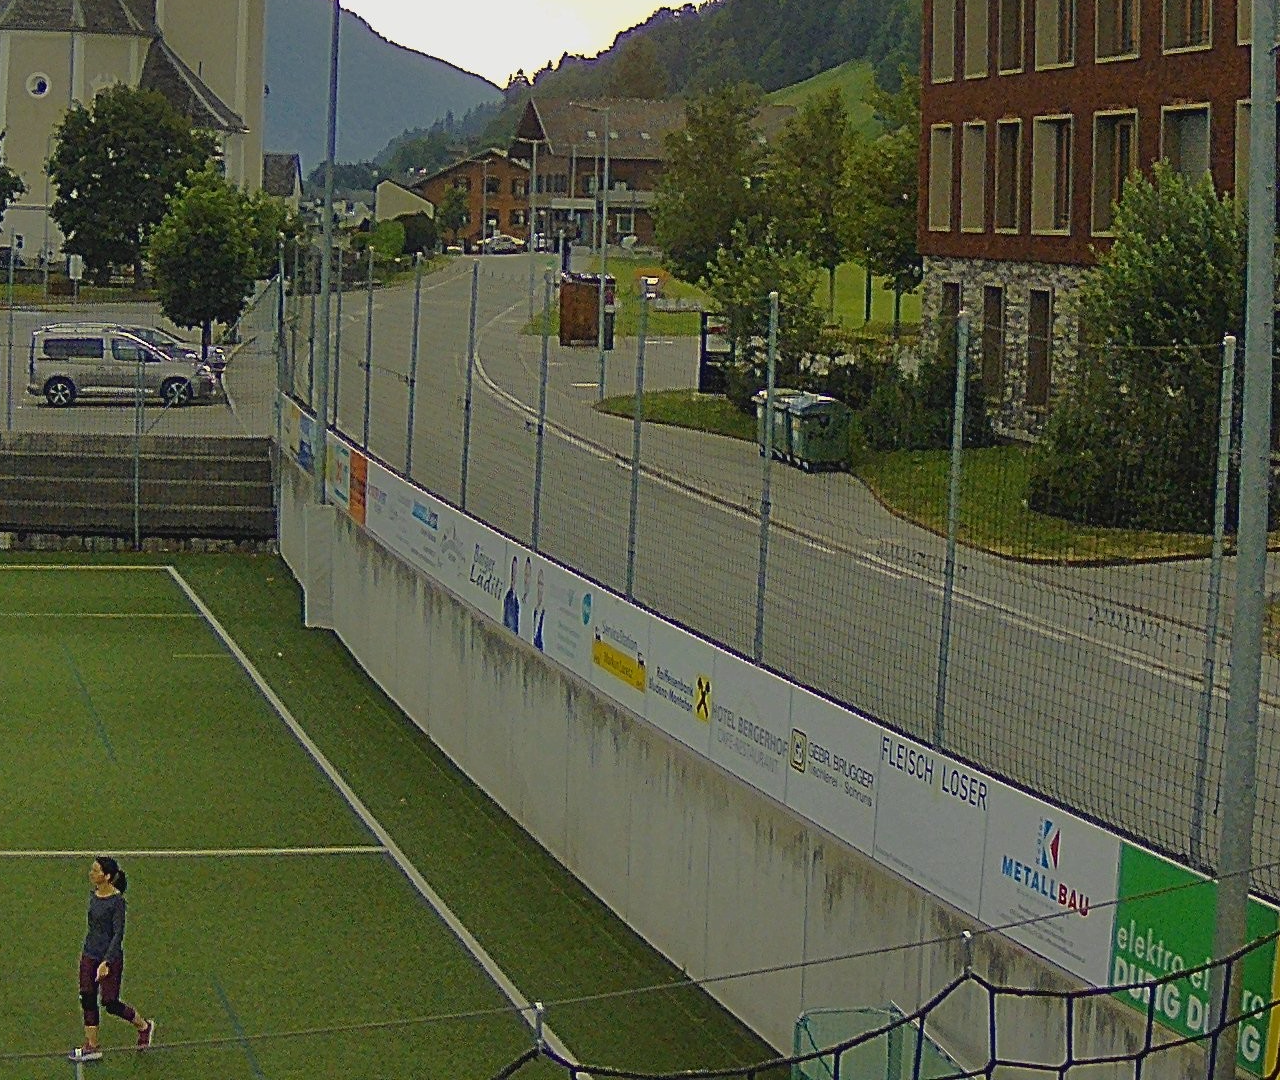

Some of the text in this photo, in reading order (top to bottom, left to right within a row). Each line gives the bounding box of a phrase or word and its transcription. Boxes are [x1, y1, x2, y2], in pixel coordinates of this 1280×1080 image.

[737, 716, 790, 758] BERGERHOF
[833, 754, 875, 789] BRUGGER
[881, 736, 988, 811] FLEISCH LOSER
[1001, 855, 1090, 917] METALLBAU
[1117, 920, 1185, 974] elektro
